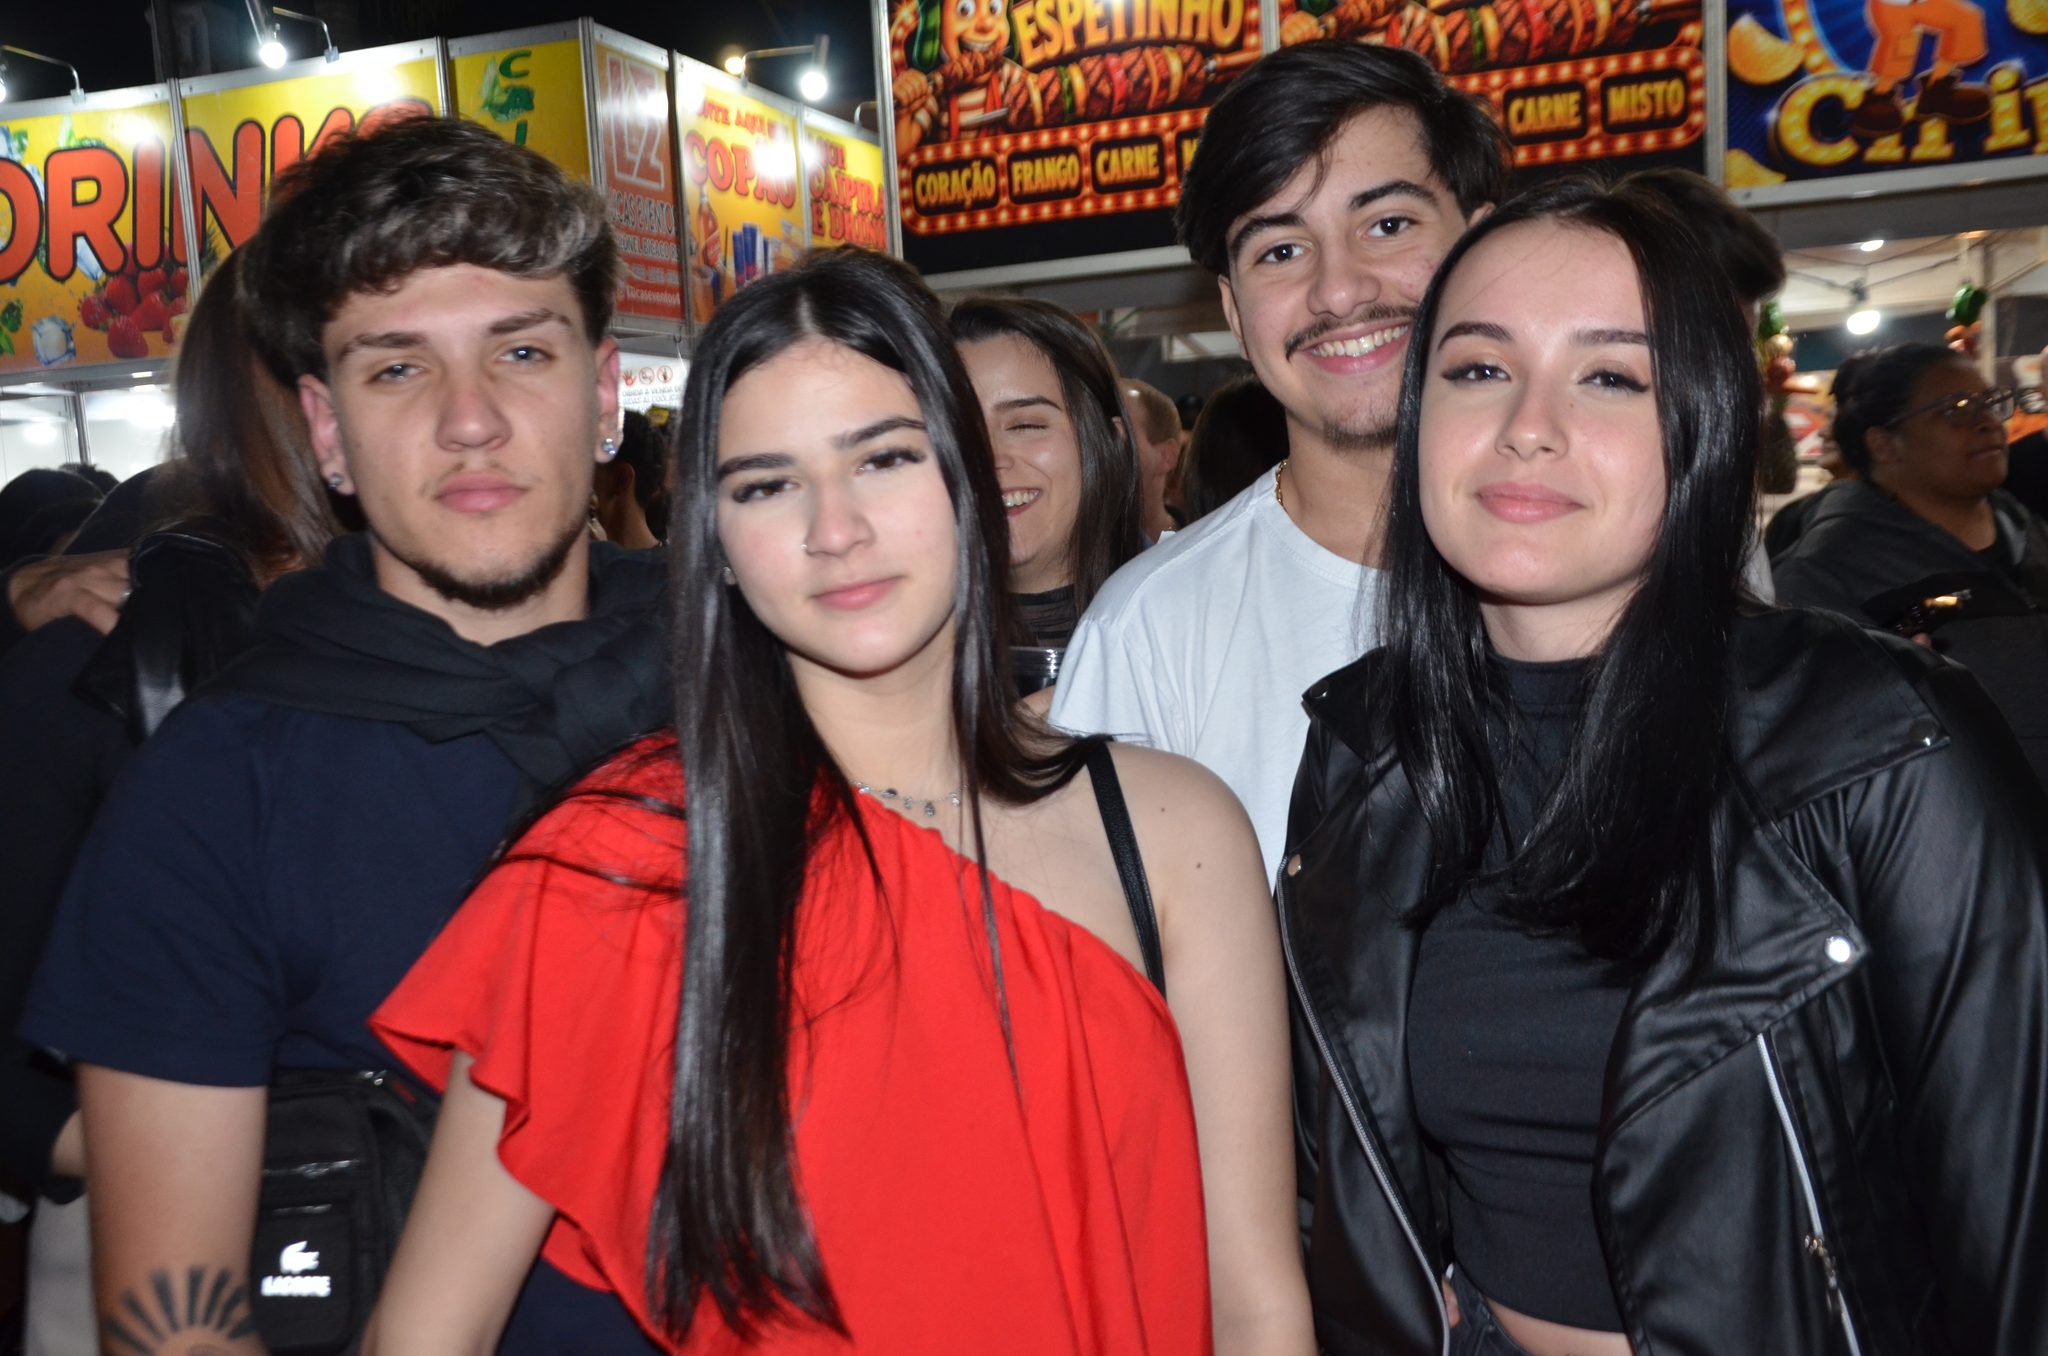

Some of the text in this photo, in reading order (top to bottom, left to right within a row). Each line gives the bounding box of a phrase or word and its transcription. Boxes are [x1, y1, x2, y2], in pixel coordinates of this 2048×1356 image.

[1012, 0, 1244, 69] ESPETINHO
[1508, 79, 1685, 135] CARNE MISTO
[0, 96, 436, 284] DRIN
[915, 160, 997, 210] CORAÇÃO
[1011, 154, 1080, 194] FRANGO
[1095, 143, 1160, 186] CARNE
[811, 200, 825, 237] E
